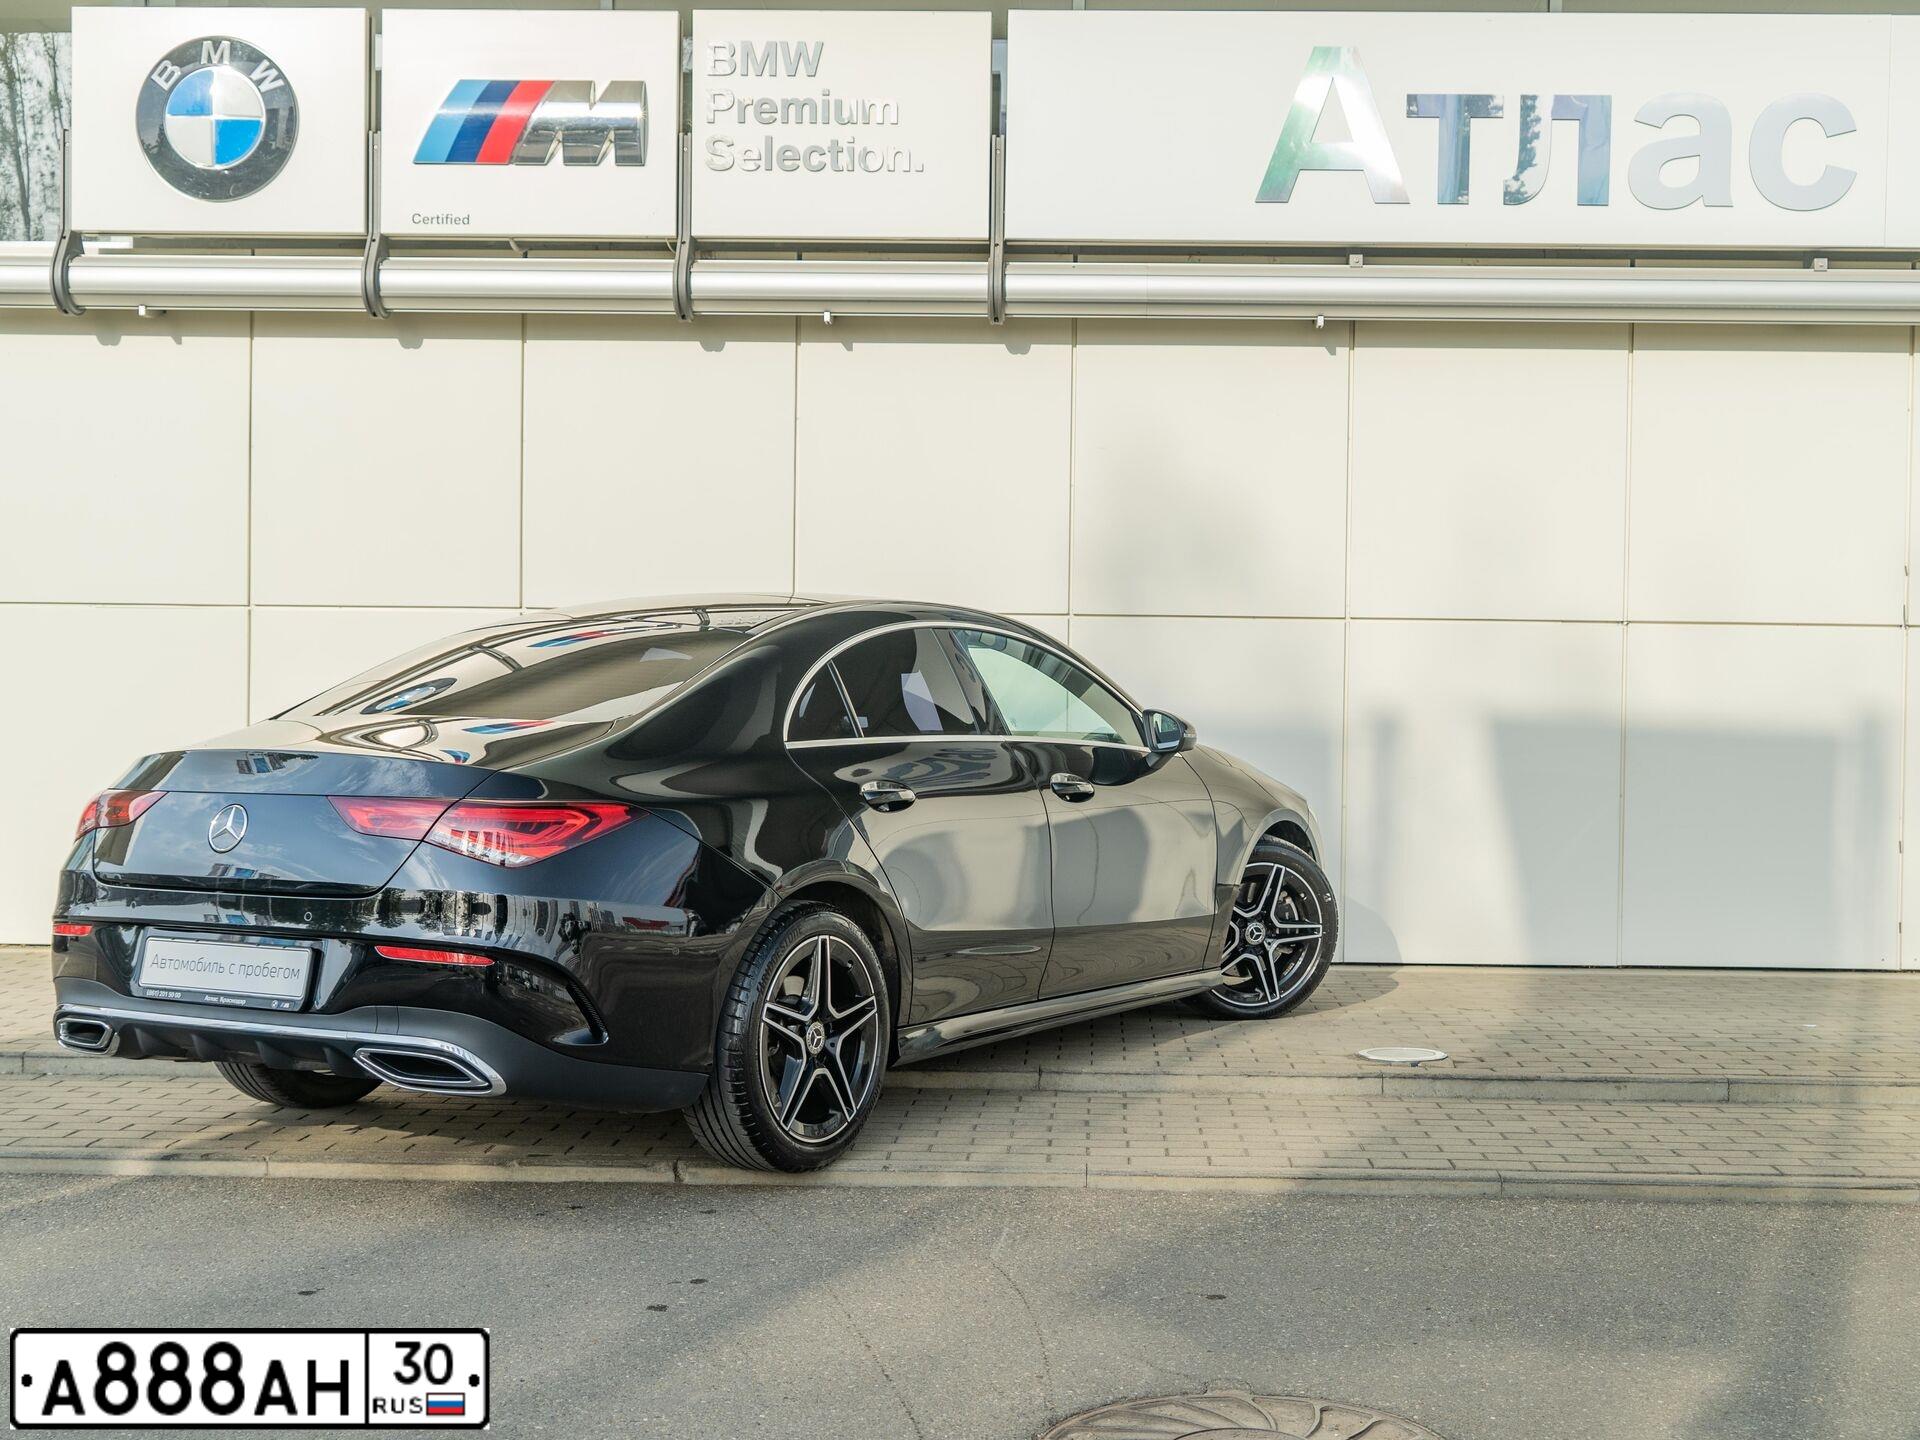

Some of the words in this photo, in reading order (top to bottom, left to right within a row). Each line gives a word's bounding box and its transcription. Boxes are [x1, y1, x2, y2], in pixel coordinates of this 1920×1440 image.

[151, 40, 285, 92] BMW
[706, 40, 824, 77] BMW
[510, 79, 648, 167] M
[706, 87, 900, 126] Premium
[1255, 45, 1858, 212] Атлас
[705, 134, 925, 173] Selection.
[411, 212, 470, 225] Certified
[151, 953, 225, 975] Автомобиль
[228, 962, 234, 974] с
[238, 961, 300, 979] пробегом
